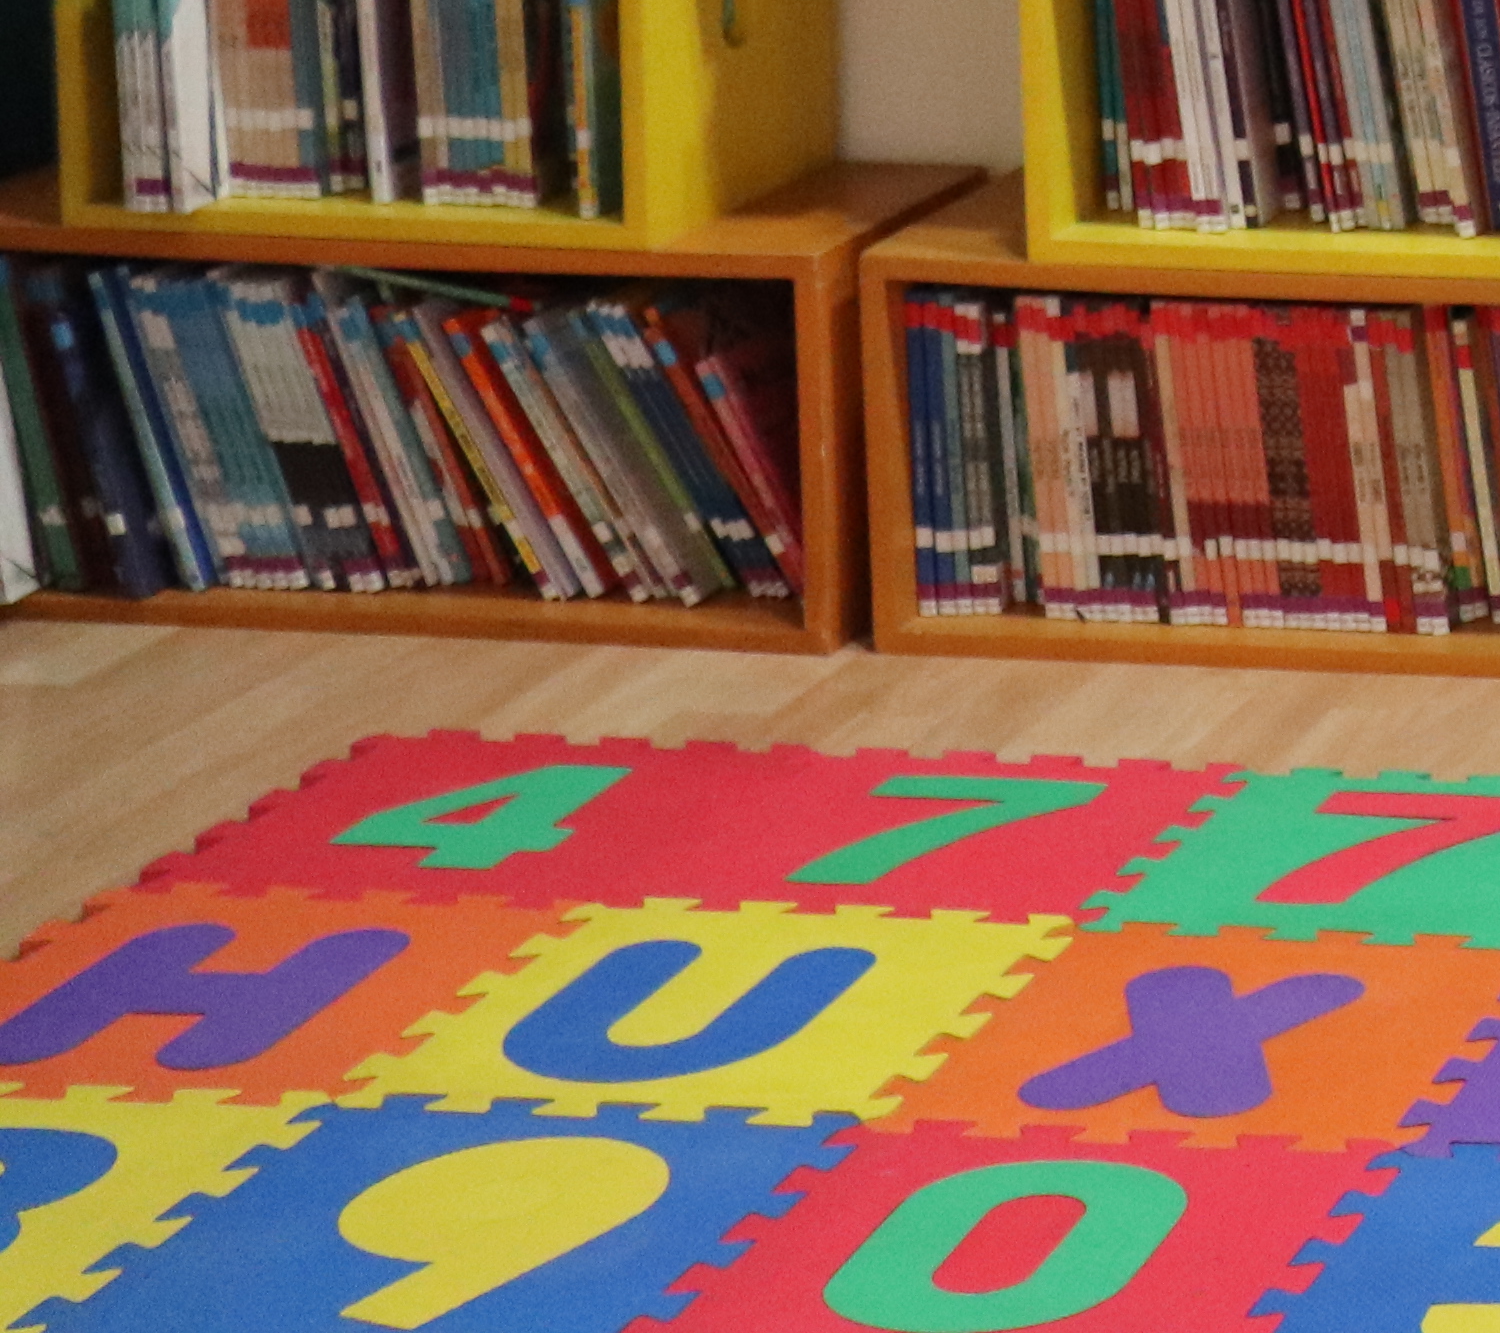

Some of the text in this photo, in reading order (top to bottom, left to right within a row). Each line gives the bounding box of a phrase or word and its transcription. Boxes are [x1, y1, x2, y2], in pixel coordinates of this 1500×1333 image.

[331, 763, 632, 870] 4
[784, 774, 1109, 885] 7
[0, 922, 411, 1073] H
[501, 938, 877, 1084] U
[1015, 964, 1367, 1119] X
[337, 1135, 671, 1332] 9
